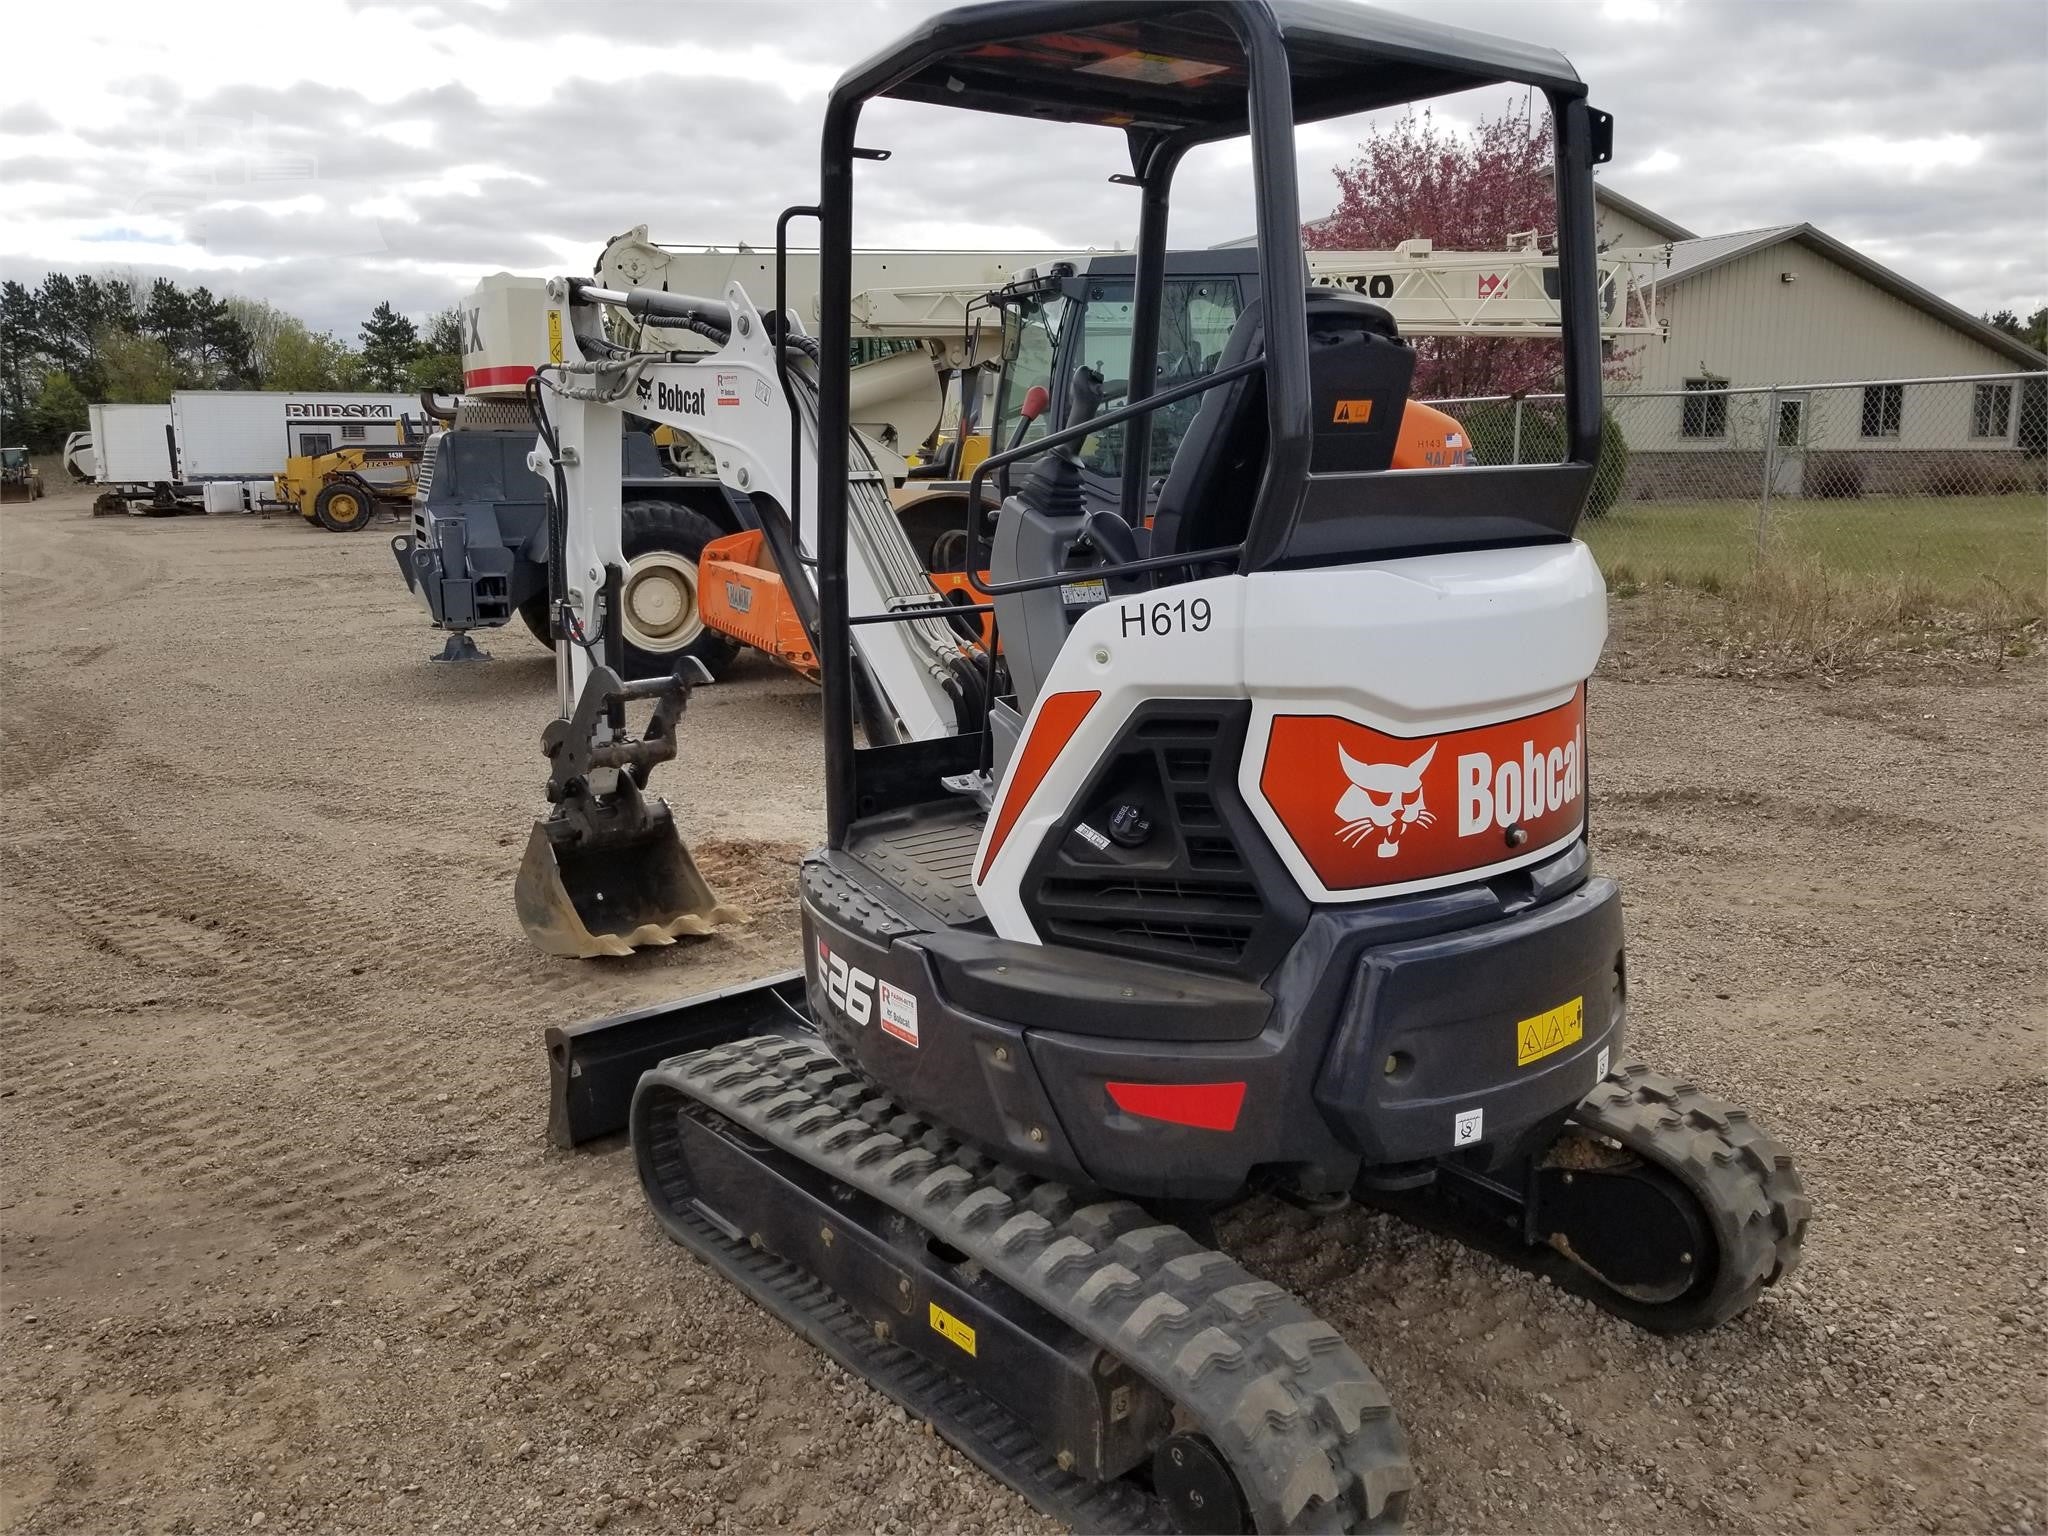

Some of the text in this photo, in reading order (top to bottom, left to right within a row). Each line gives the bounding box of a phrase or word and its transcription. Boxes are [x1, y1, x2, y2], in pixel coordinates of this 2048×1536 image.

[658, 382, 706, 416] Bobcat
[1121, 598, 1211, 637] H619
[1458, 723, 1581, 837] Bobcat
[1114, 805, 1130, 824] DIESEL
[817, 935, 876, 1026] E26
